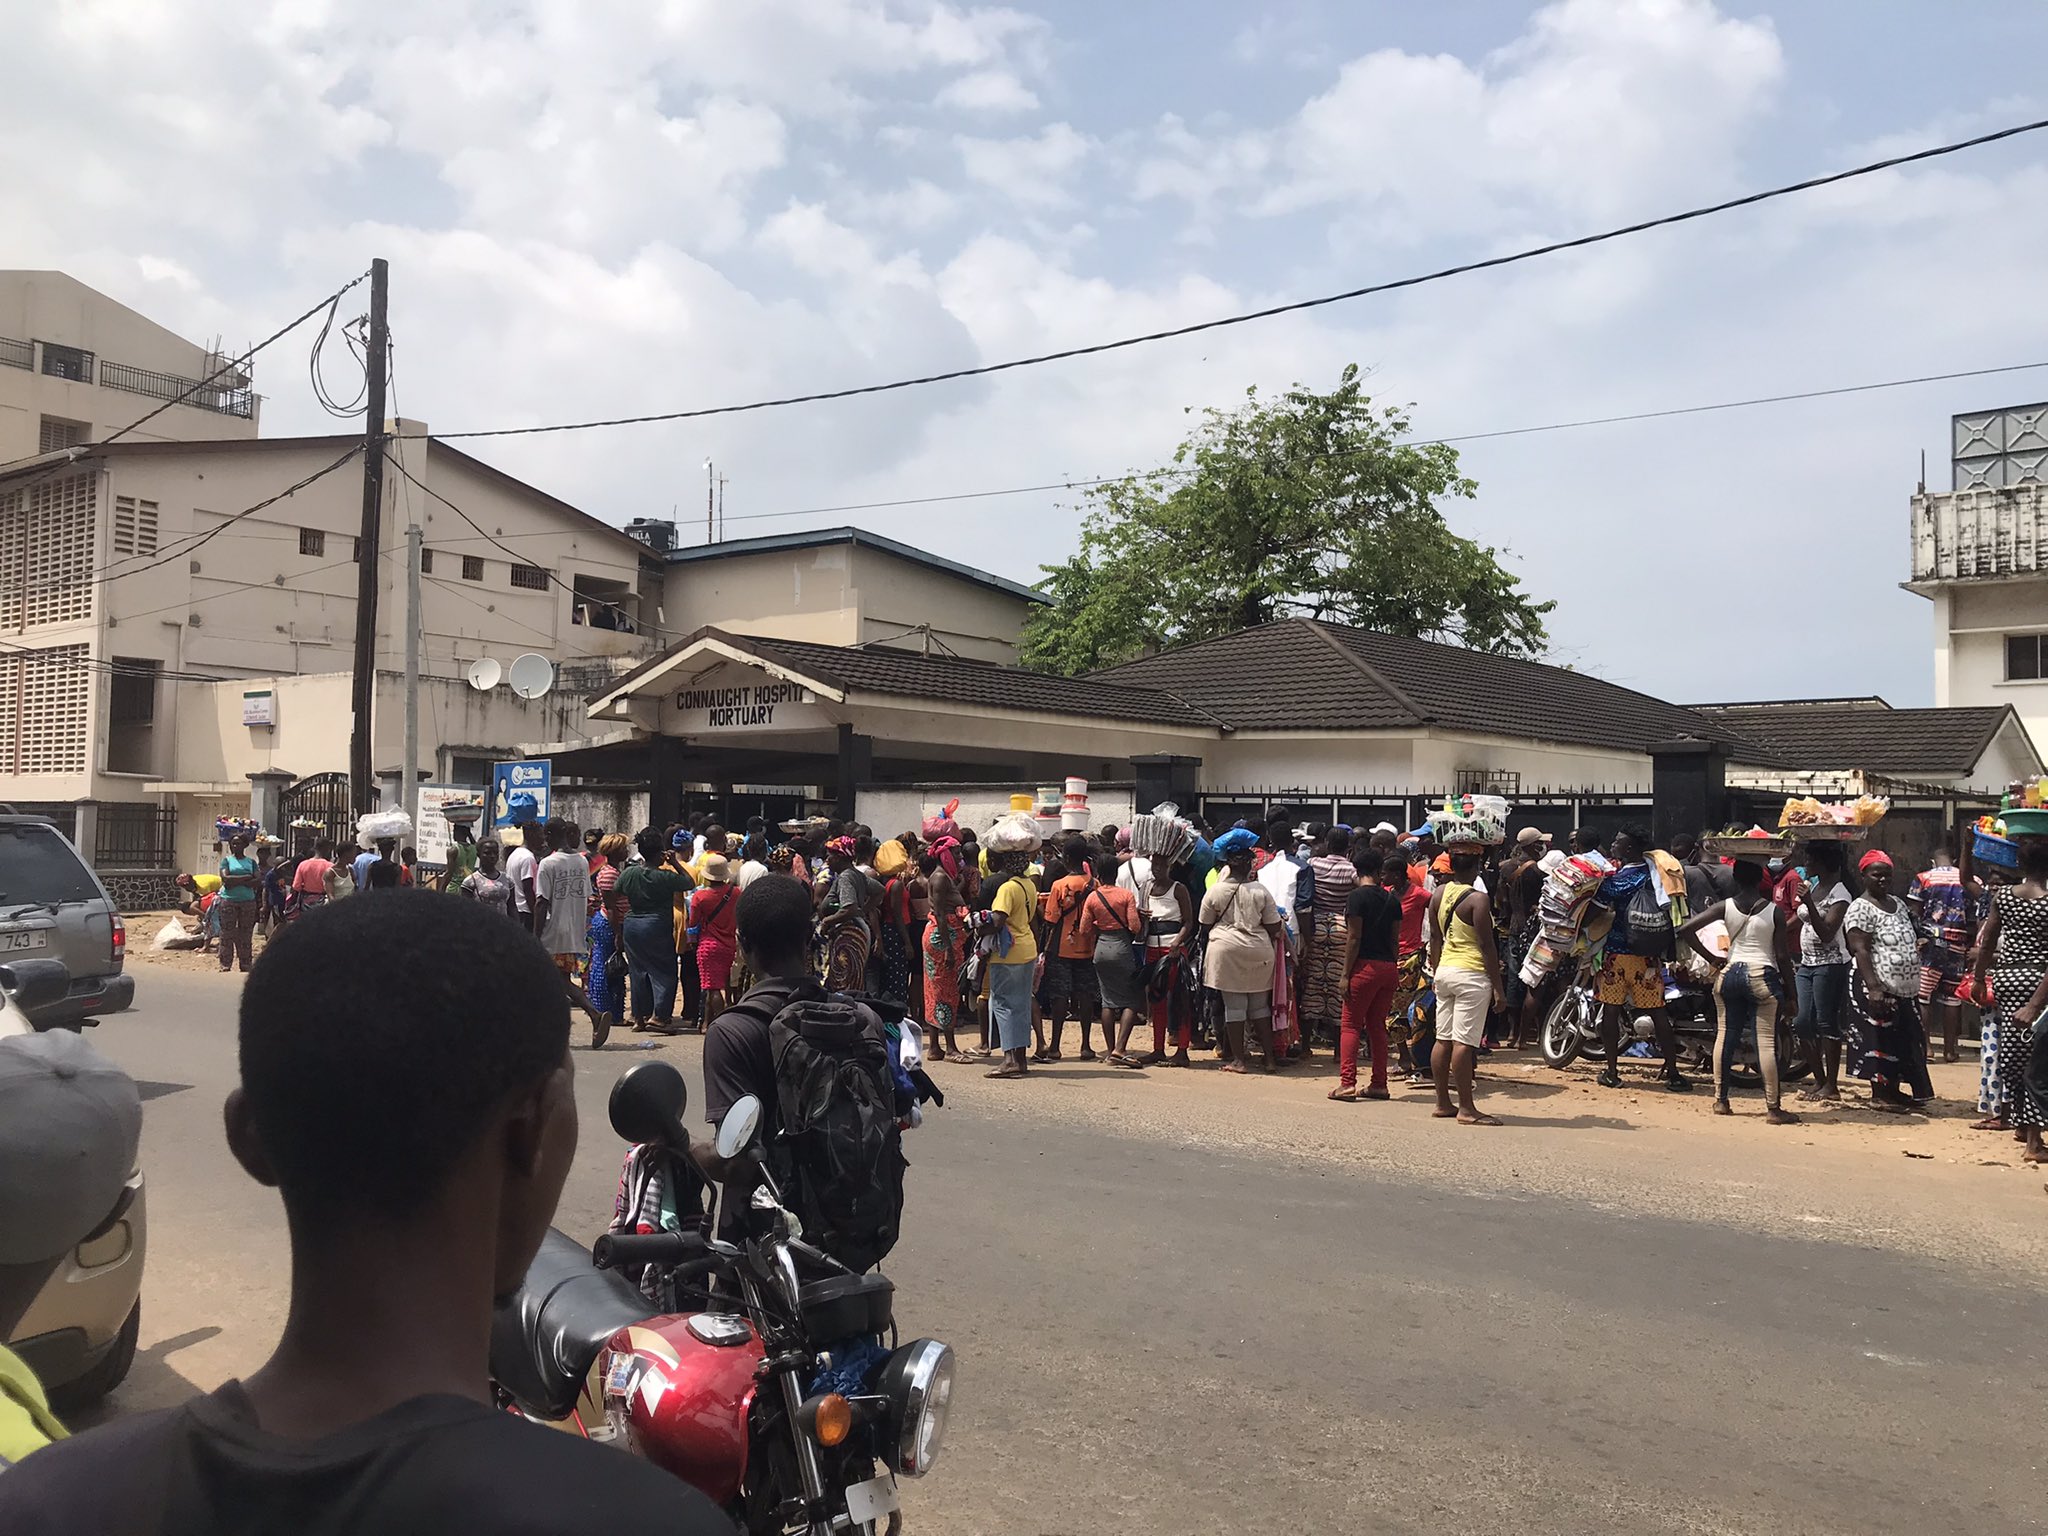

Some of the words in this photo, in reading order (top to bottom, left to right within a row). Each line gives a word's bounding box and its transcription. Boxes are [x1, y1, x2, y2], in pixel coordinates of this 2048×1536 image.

[677, 687, 750, 710] CONNAUGHT
[709, 705, 775, 726] MORTUARY
[6, 933, 30, 950] 743
